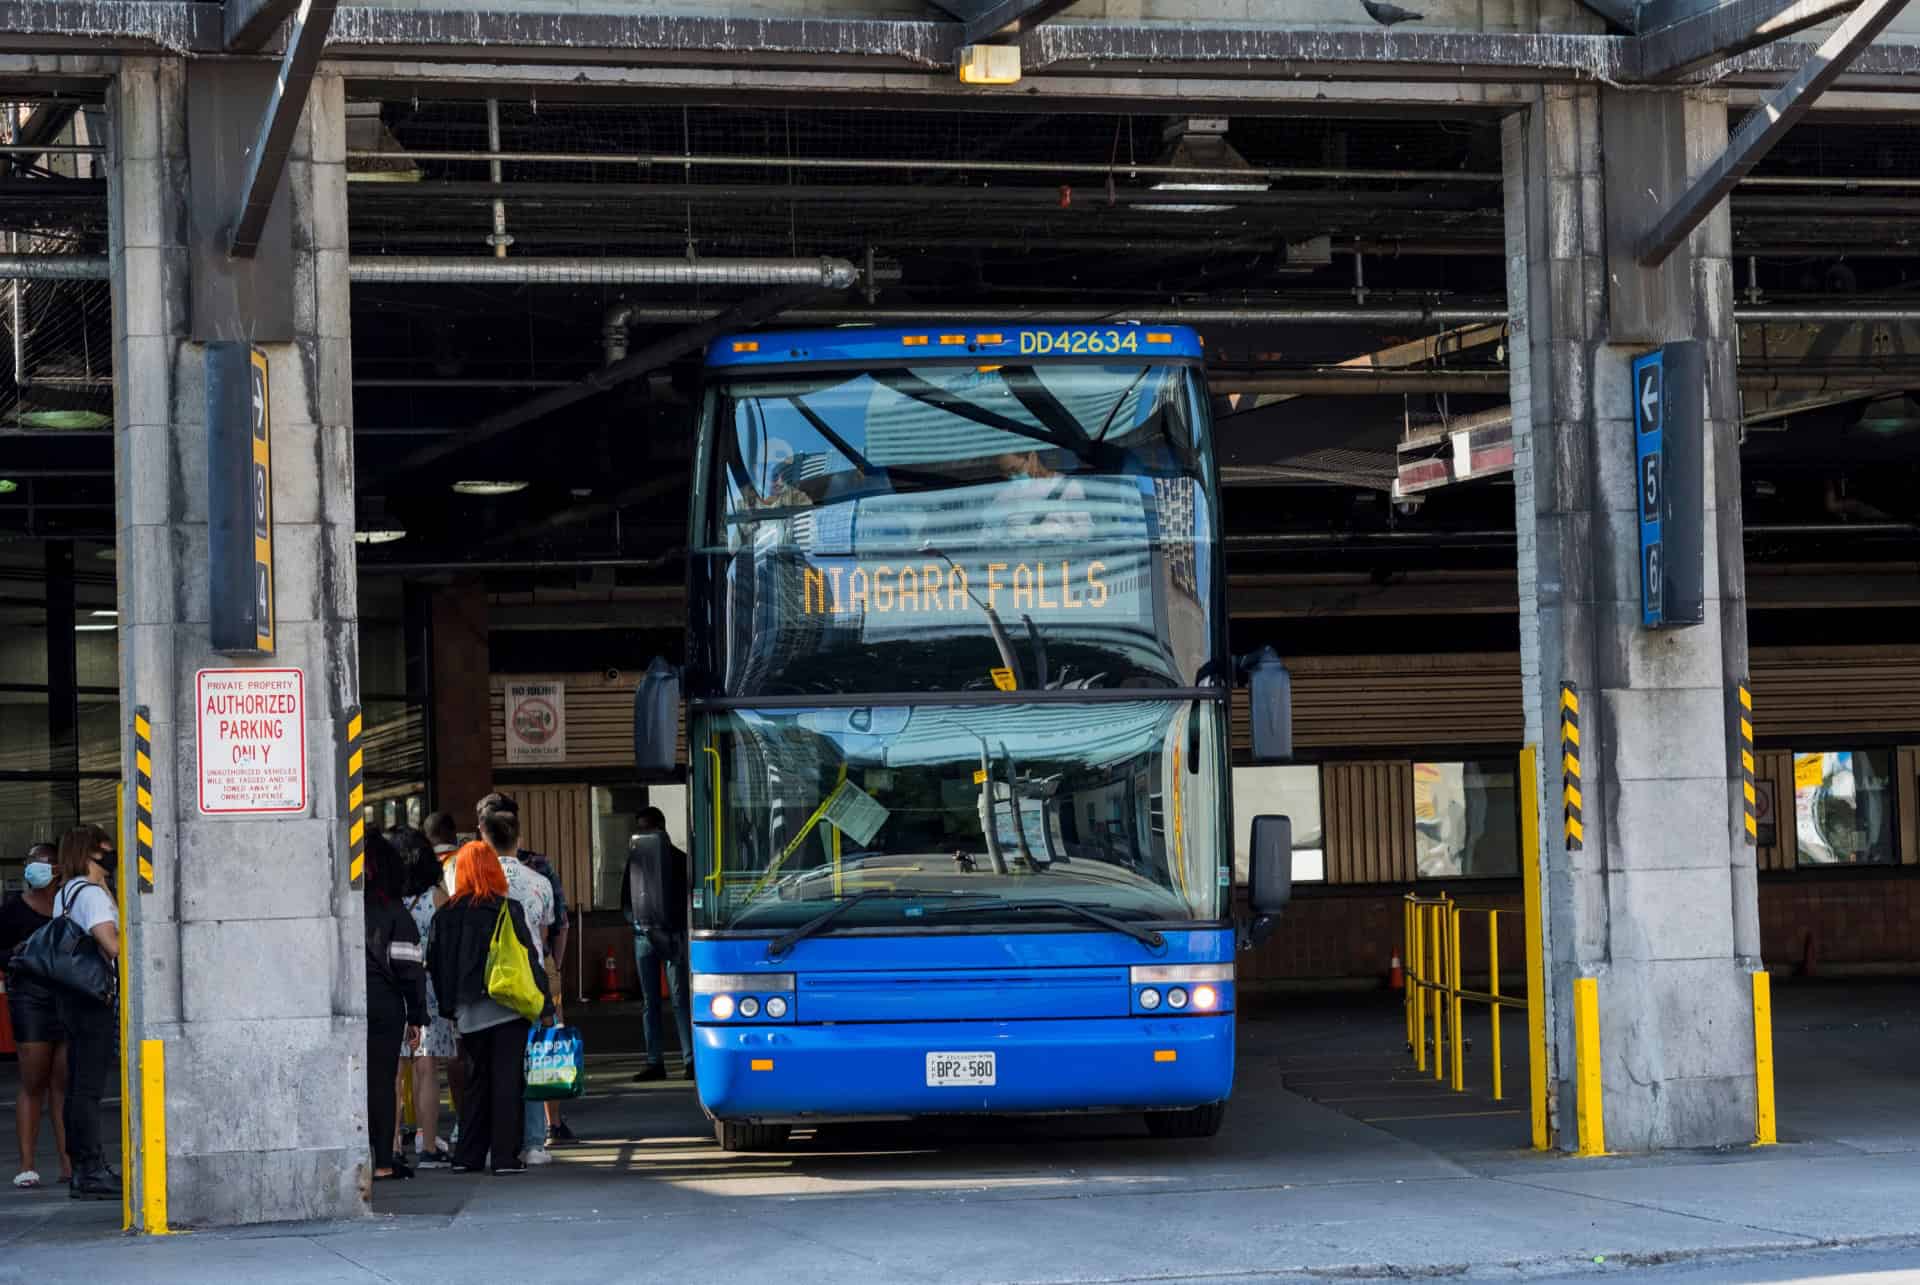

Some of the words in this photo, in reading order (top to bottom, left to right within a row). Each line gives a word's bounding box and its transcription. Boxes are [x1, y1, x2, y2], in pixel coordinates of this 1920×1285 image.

[1019, 330, 1138, 355] DD42634
[257, 470, 265, 521] 3
[1647, 461, 1656, 505] 5
[803, 563, 969, 615] NIAGARA
[987, 560, 1108, 611] FALLS
[1649, 550, 1658, 593] 6
[259, 570, 267, 617] 4
[207, 681, 244, 691] PRIVATE
[247, 680, 294, 690] PROPERTY
[206, 694, 296, 715] AUTHORIZED
[219, 719, 283, 740] PARKING
[936, 1060, 961, 1078] BP2
[968, 1060, 993, 1078] 580
